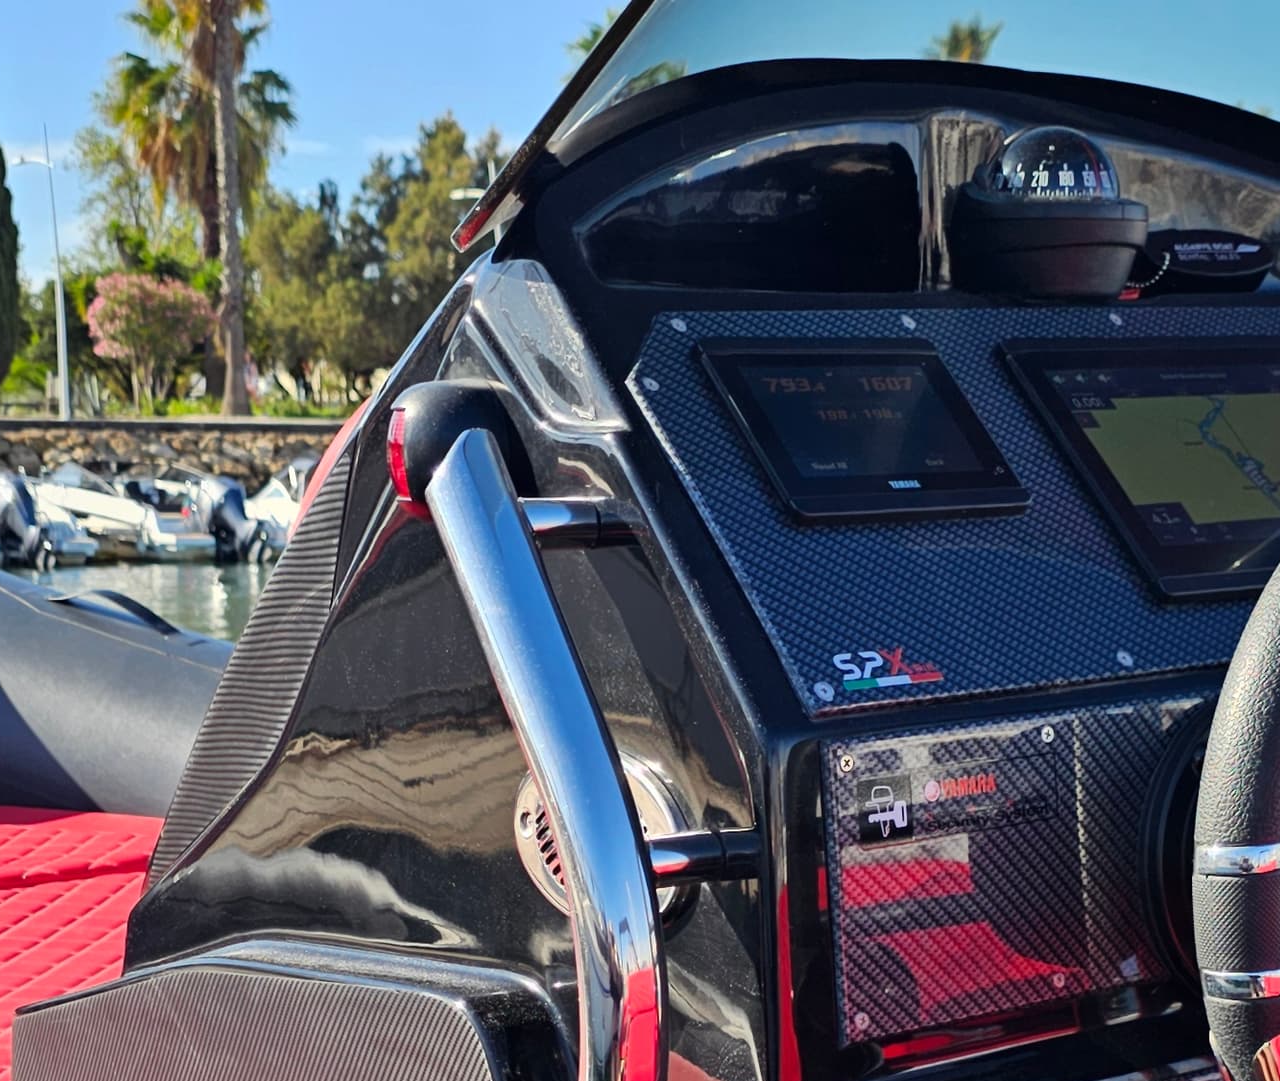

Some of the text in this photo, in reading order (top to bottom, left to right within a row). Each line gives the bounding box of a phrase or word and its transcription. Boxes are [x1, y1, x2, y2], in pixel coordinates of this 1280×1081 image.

[1031, 170, 1049, 187] 210
[1059, 170, 1074, 187] 180
[833, 647, 914, 681] SPX
[940, 772, 998, 798] YAMAHA
